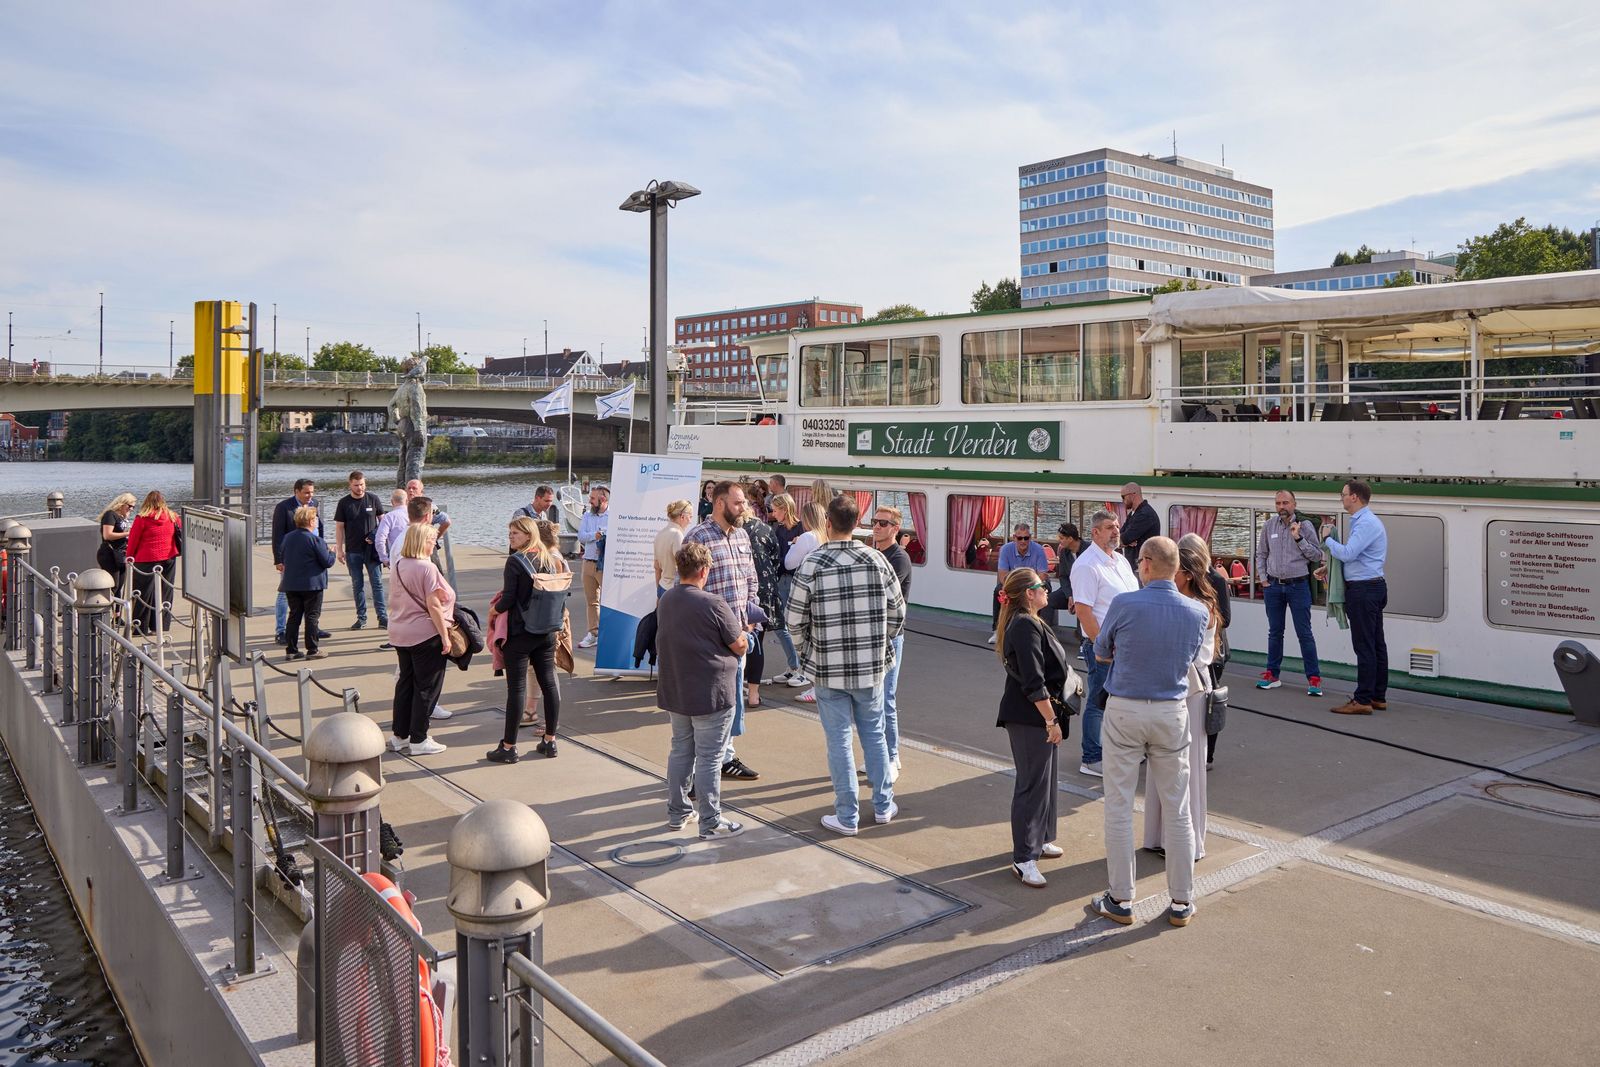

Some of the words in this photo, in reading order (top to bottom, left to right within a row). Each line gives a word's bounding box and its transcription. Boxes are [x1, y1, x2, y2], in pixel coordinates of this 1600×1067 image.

[802, 418, 845, 430] 04033250
[802, 439, 814, 447] 250
[815, 440, 845, 448] Personen
[882, 426, 935, 454] Stadt
[640, 463, 660, 474] bpa
[202, 549, 207, 578] D
[1511, 582, 1548, 590] Abendliche
[1550, 585, 1590, 593] Grillfahrten
[1548, 603, 1589, 612] Bundesliga-
[1547, 612, 1595, 621] Weserstadion
